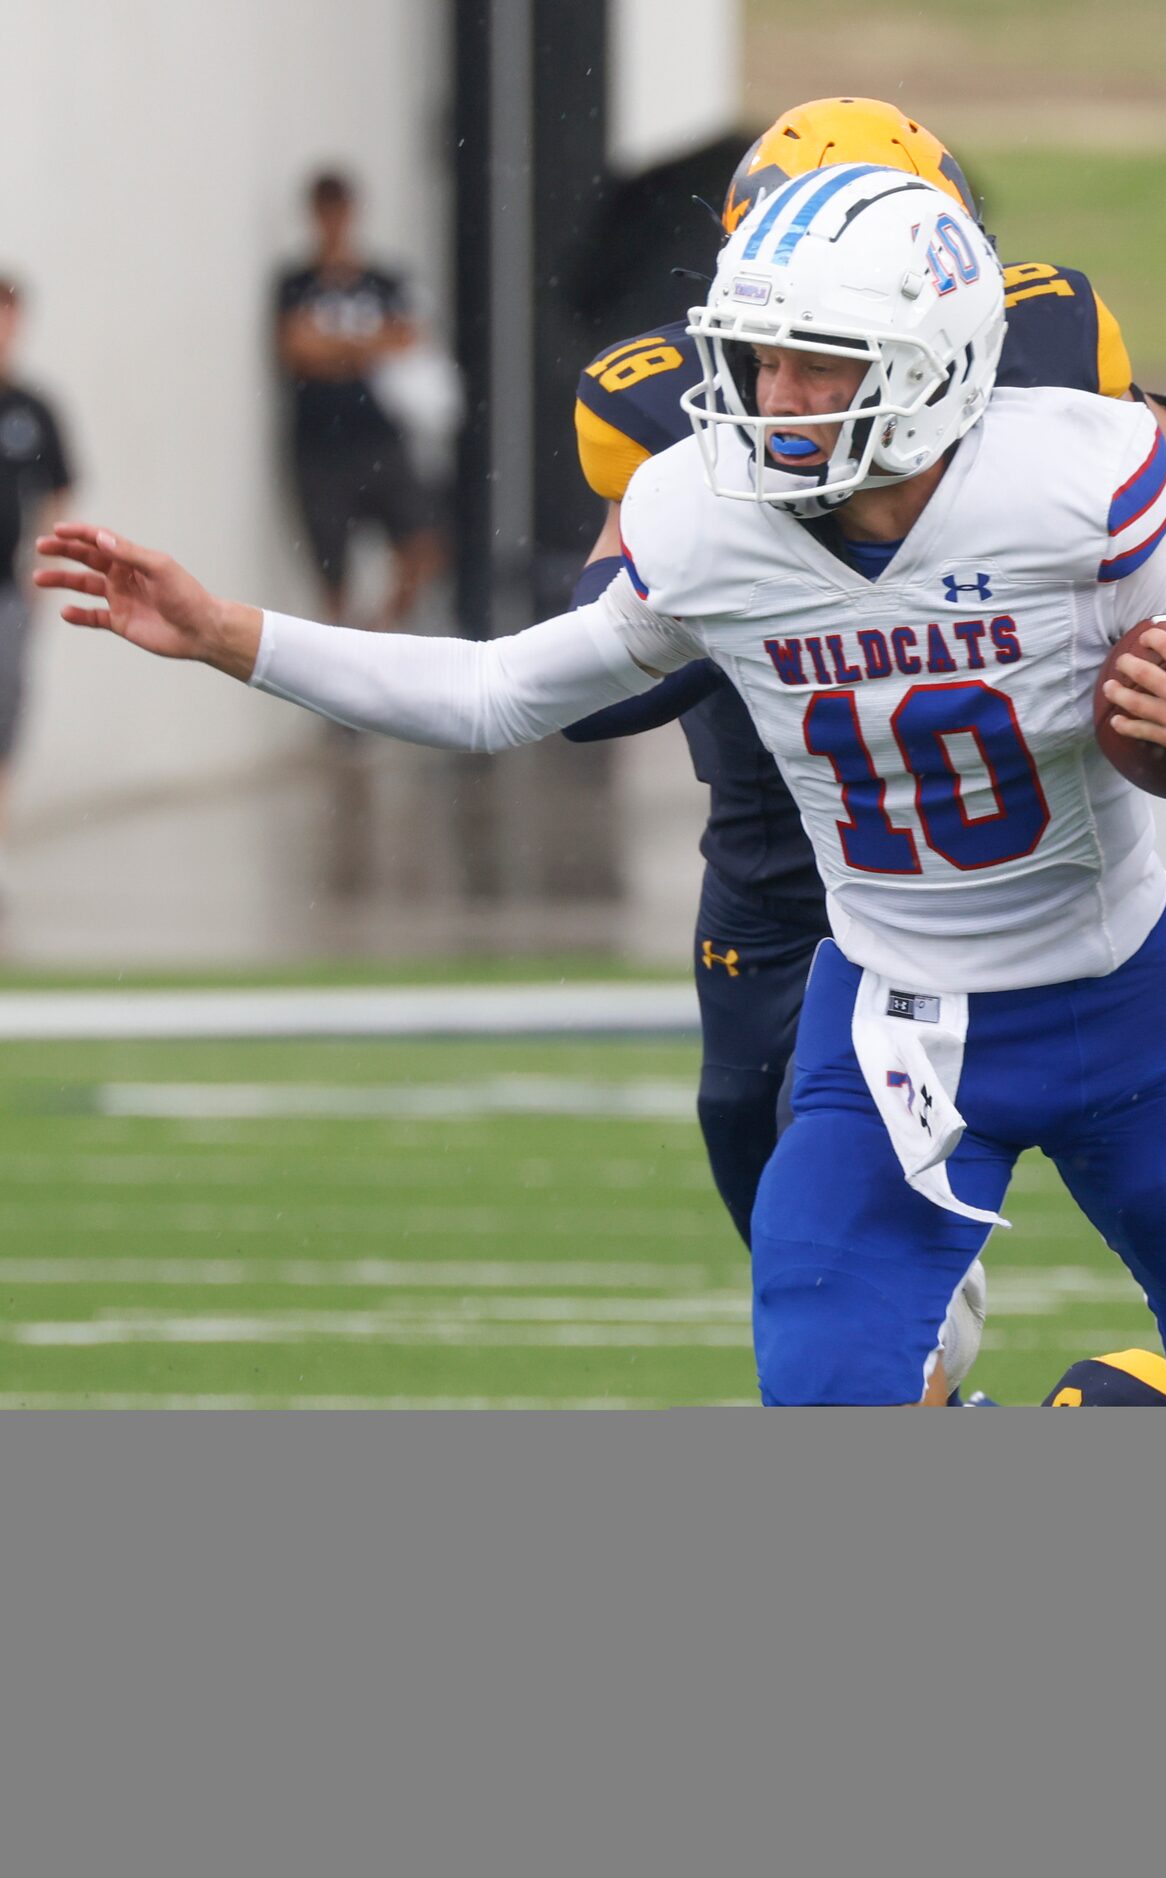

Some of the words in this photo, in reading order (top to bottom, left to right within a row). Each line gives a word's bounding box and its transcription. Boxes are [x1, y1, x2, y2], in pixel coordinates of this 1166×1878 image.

[911, 212, 980, 297] 10
[585, 336, 685, 394] 18
[763, 614, 1022, 685] WILDCATS
[802, 680, 1052, 875] 10
